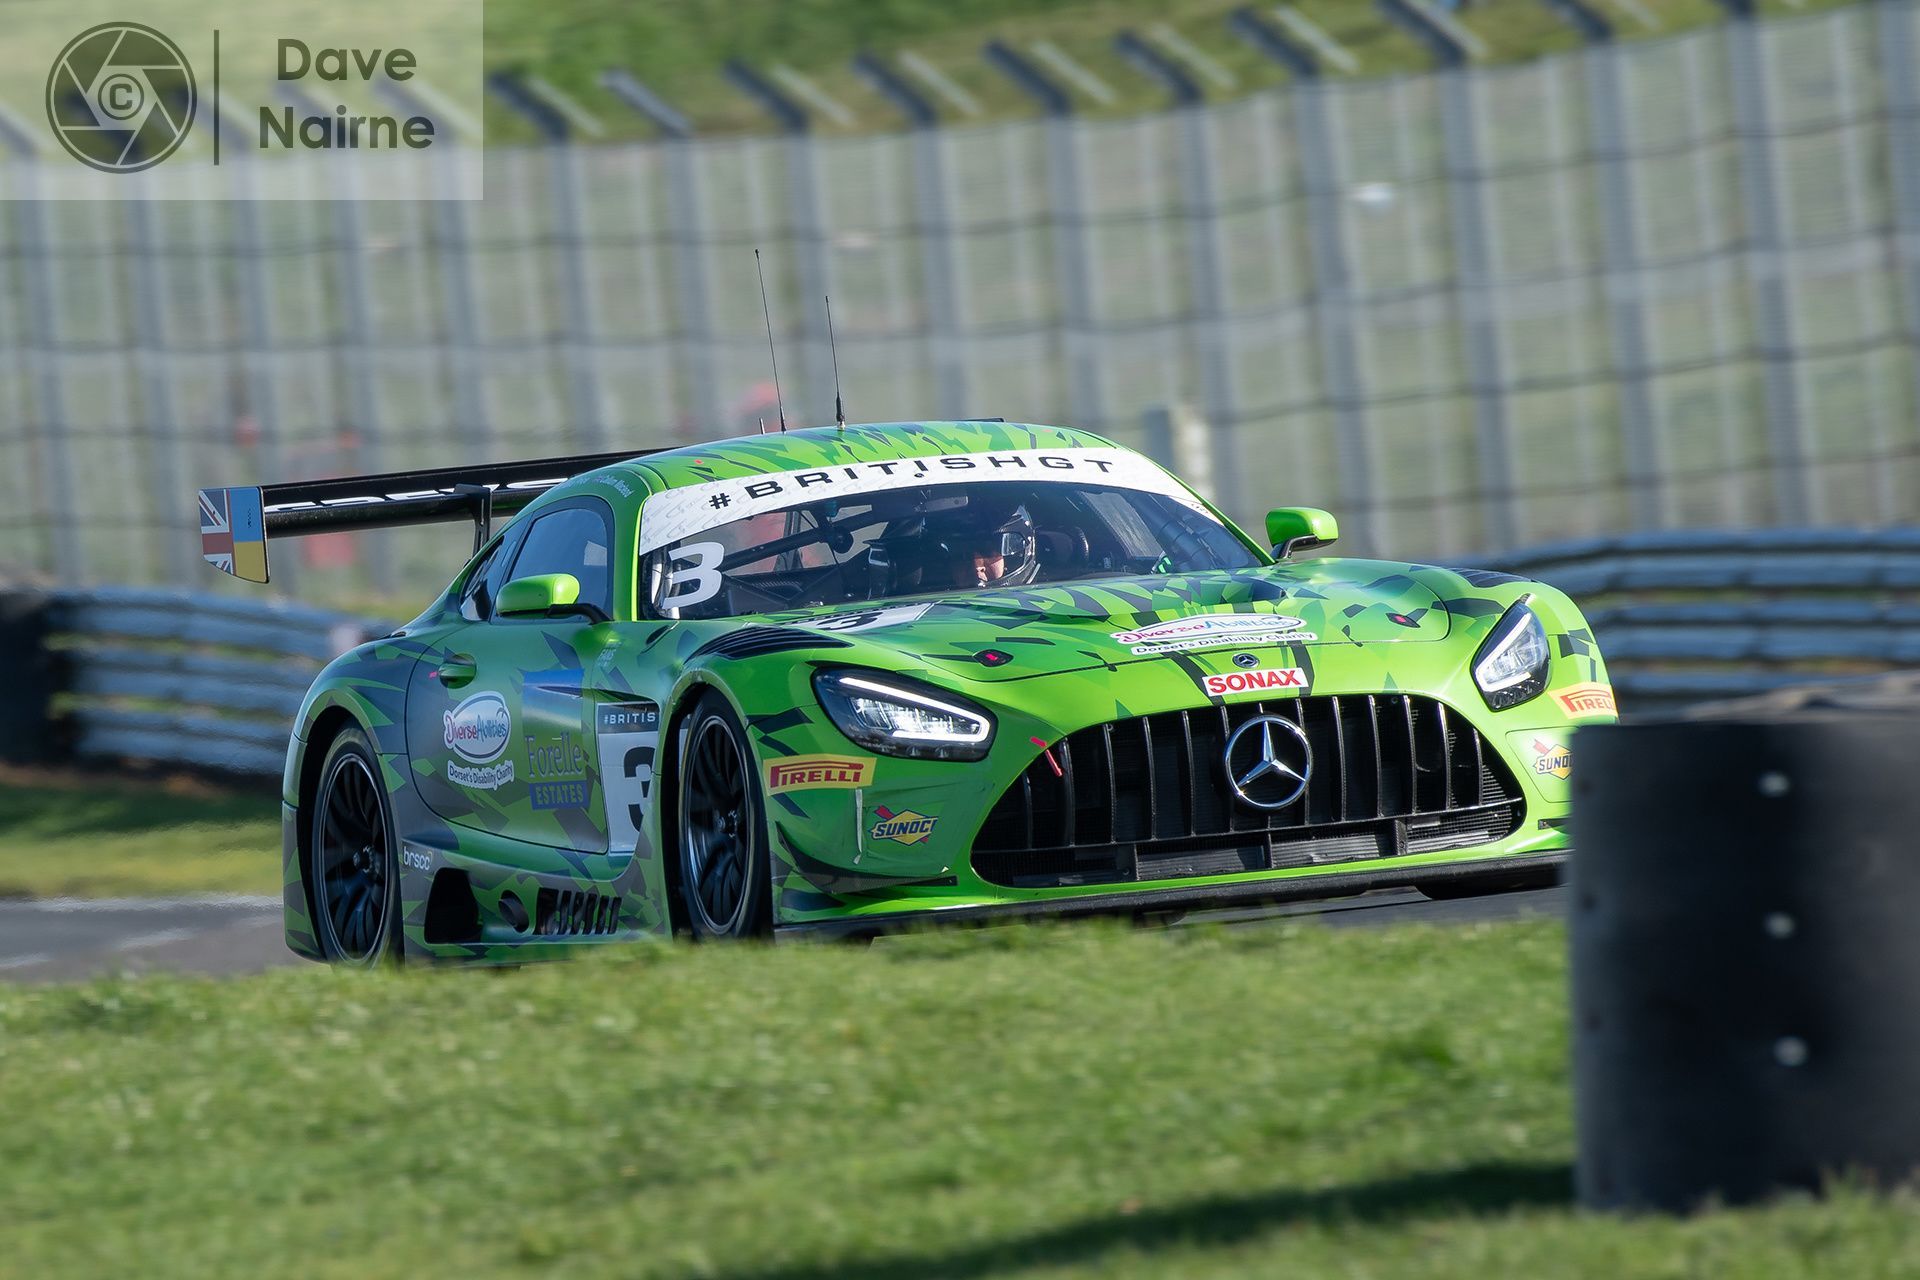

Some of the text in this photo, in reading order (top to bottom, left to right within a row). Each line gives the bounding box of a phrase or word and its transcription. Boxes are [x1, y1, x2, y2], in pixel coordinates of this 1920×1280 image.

[661, 541, 725, 610] 3
[1136, 632, 1316, 653] Dorset's Disability Charity
[1207, 669, 1302, 694] SONAX
[525, 731, 583, 778] Forelle
[1538, 754, 1573, 772] SUNO
[449, 764, 473, 782] Dorset's
[473, 769, 498, 786] Disability
[770, 760, 864, 789] PIRELLI
[535, 783, 584, 806] ESTATES
[403, 845, 431, 871] brscc
